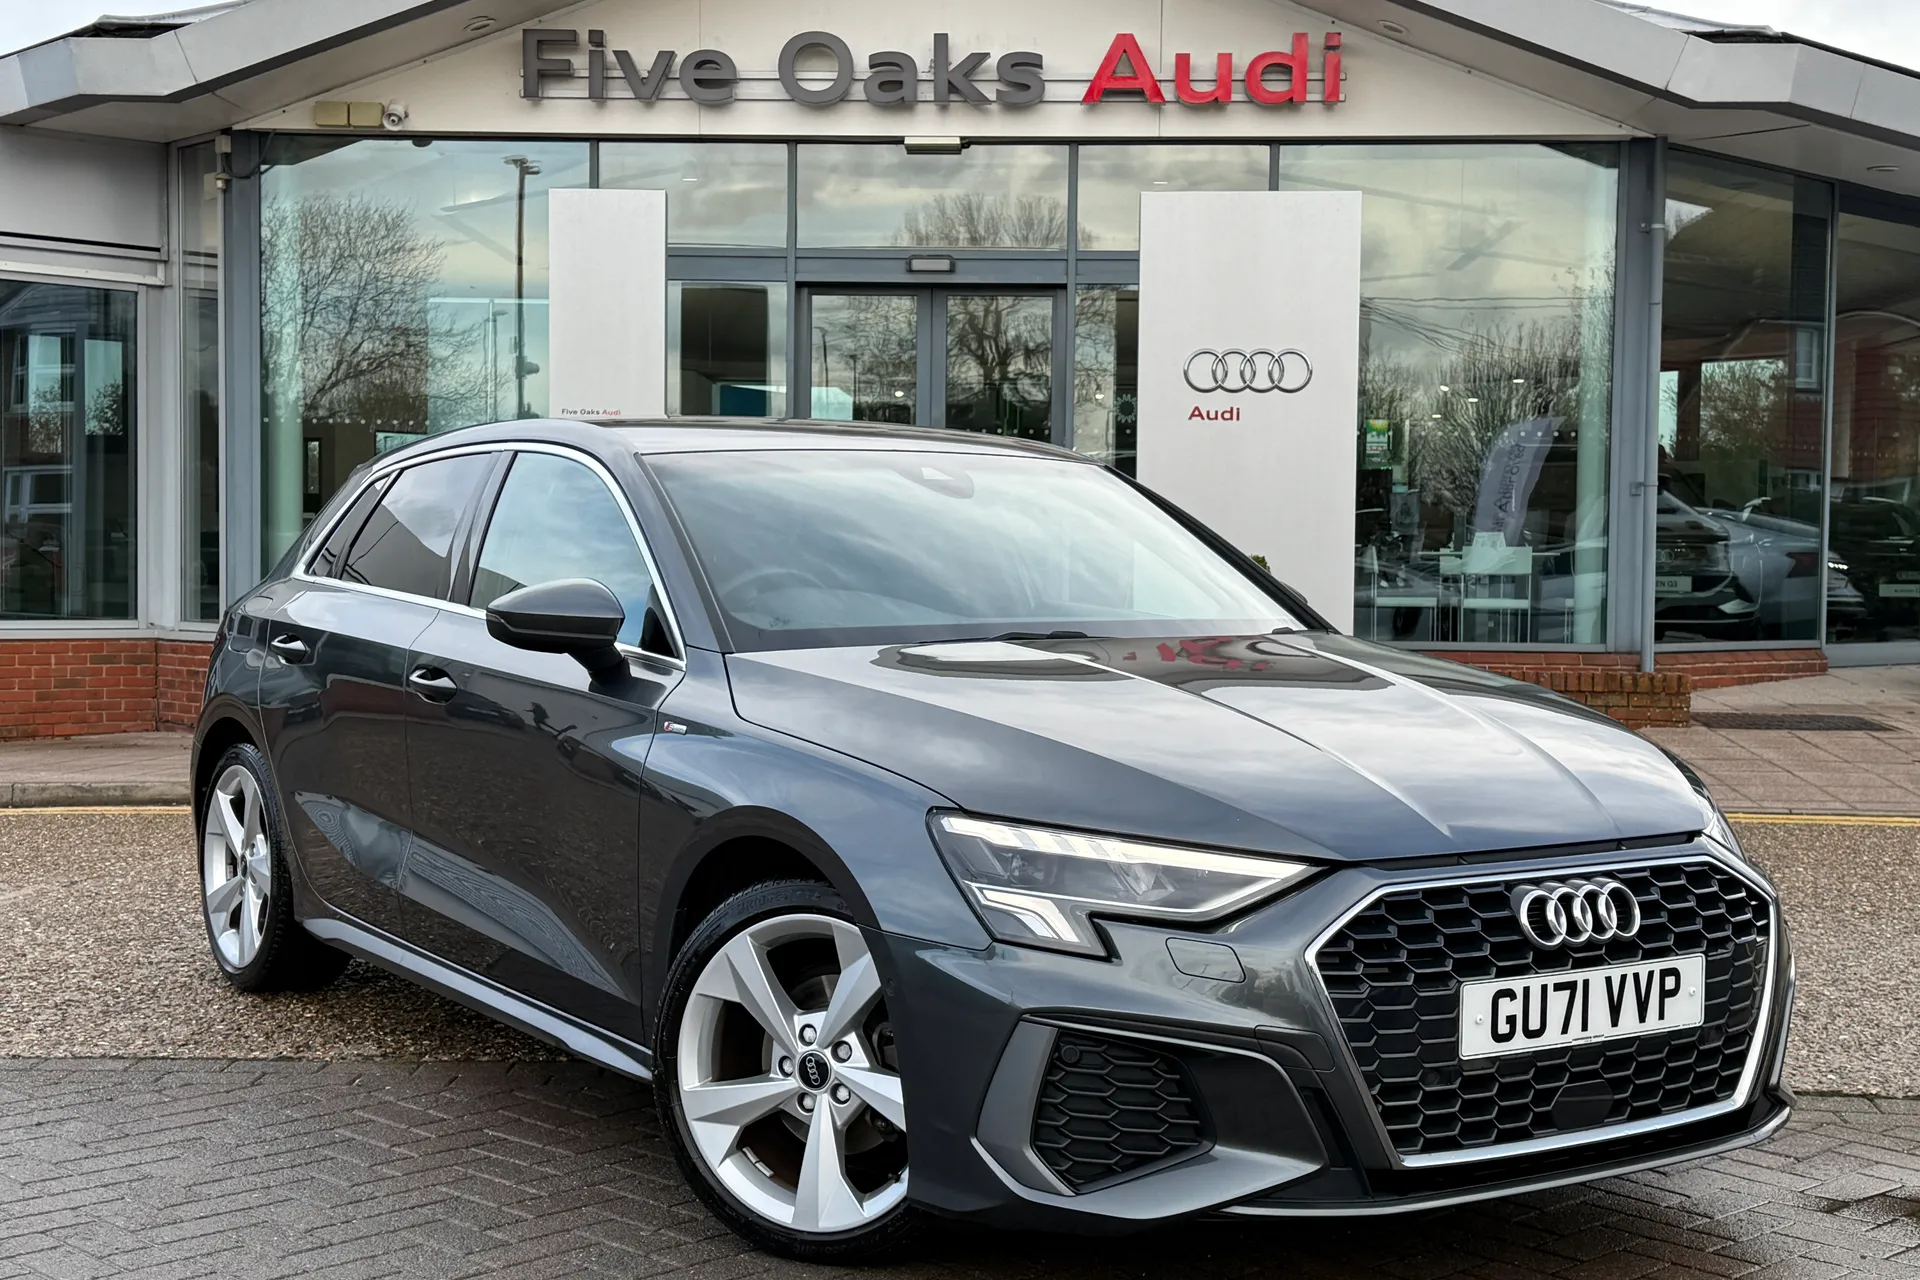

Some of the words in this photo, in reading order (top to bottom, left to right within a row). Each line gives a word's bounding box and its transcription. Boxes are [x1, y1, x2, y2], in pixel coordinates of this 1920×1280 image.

[521, 28, 738, 105] Five
[778, 30, 1045, 106] Oaks
[1081, 32, 1342, 105] Audi
[1187, 405, 1240, 421] Audi
[1490, 978, 1590, 1044] GU71
[1604, 966, 1682, 1029] VVP
